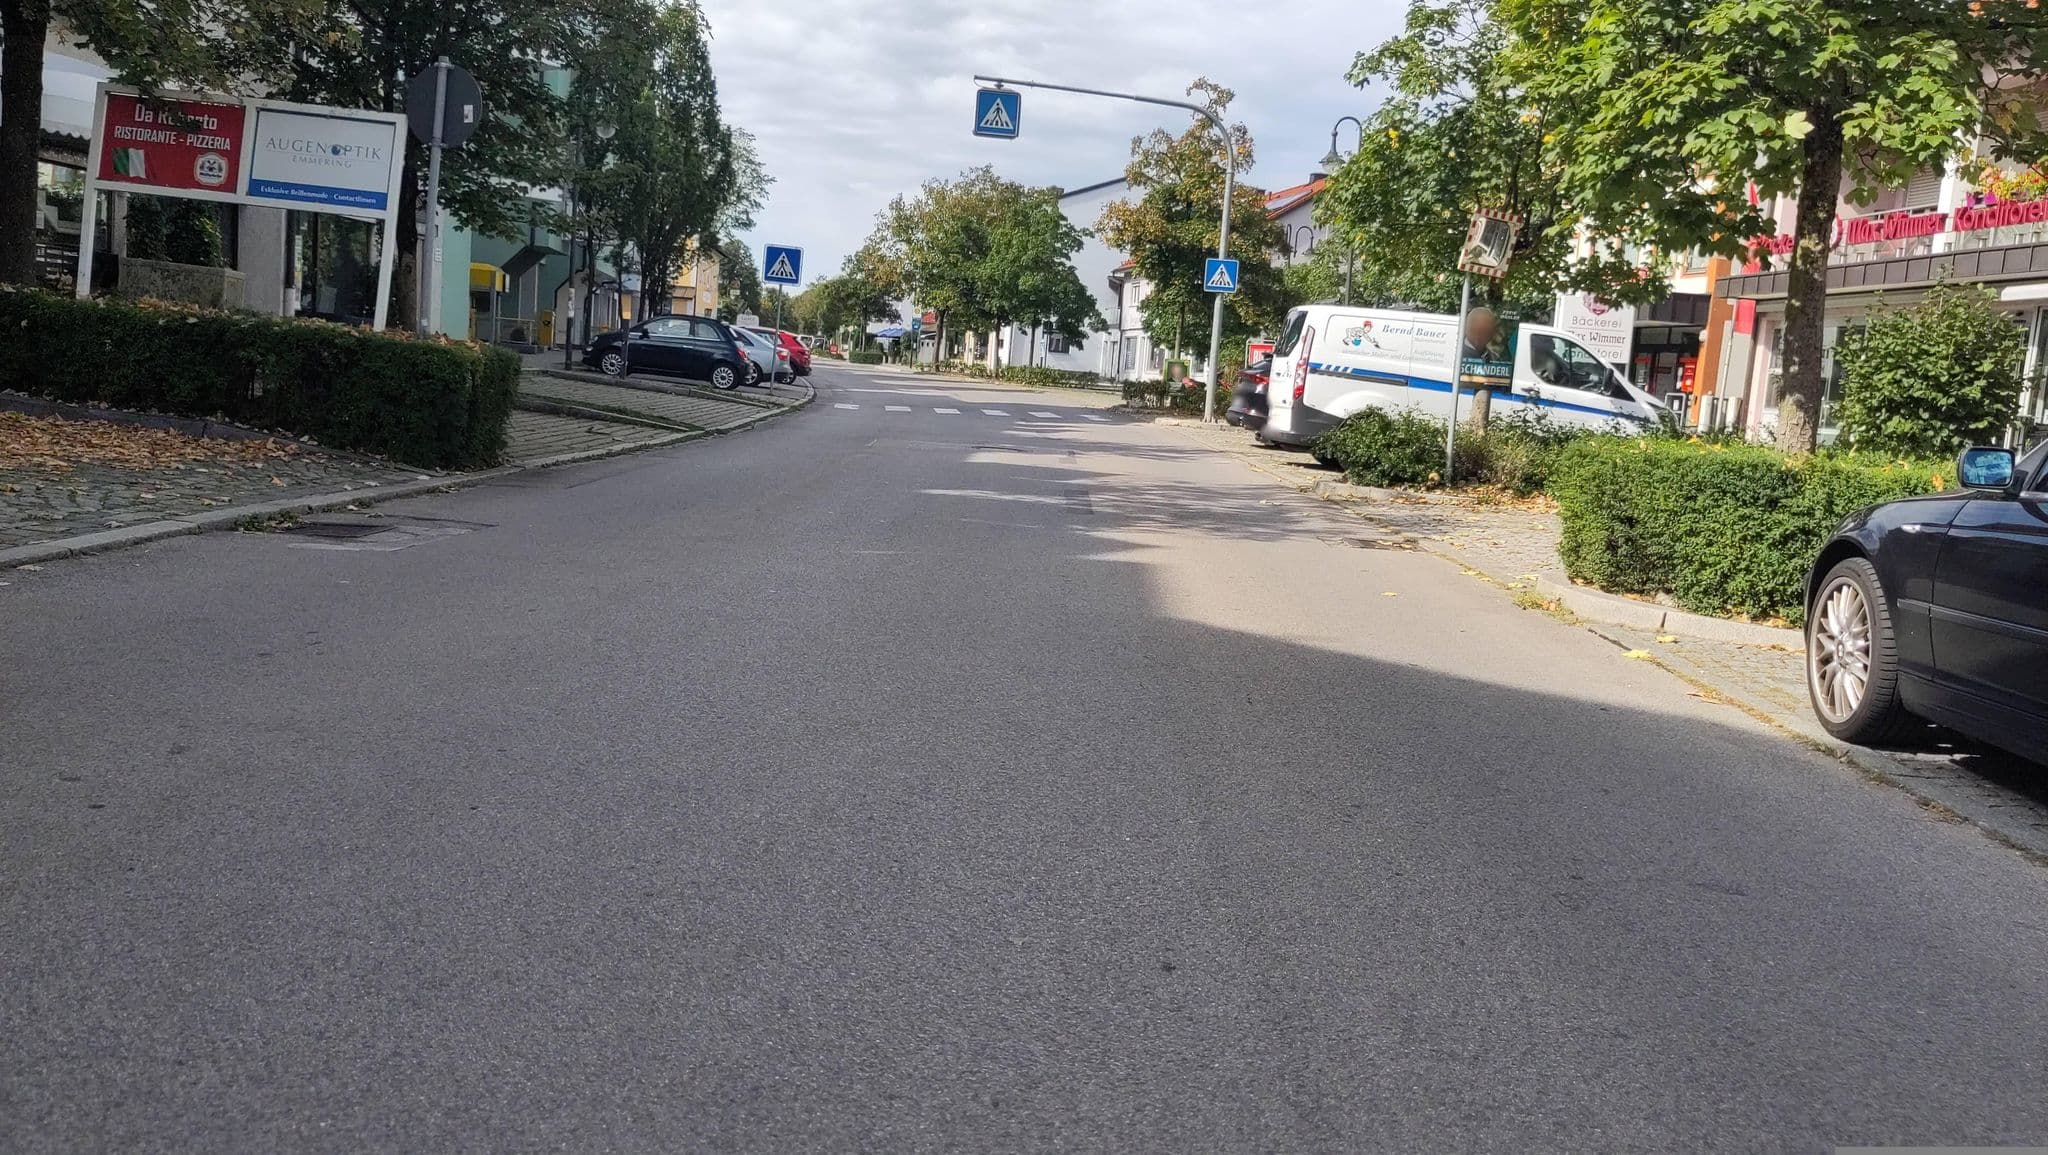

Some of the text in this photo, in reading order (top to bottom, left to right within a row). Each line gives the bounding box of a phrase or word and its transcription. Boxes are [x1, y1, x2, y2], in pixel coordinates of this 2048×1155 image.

[134, 103, 218, 131] Da Roerto
[114, 125, 177, 145] RISTORANTE
[186, 133, 231, 151] PIZZERIA
[265, 137, 383, 160] AUGENOPTIK
[292, 154, 352, 168] EMMERING
[1882, 210, 1949, 241] Wimmer
[1572, 315, 1622, 329] Bäckerei
[1382, 324, 1447, 339] Bernd Bauer
[1589, 331, 1626, 345] Wimmer
[1460, 363, 1510, 376] SCHANDERL
